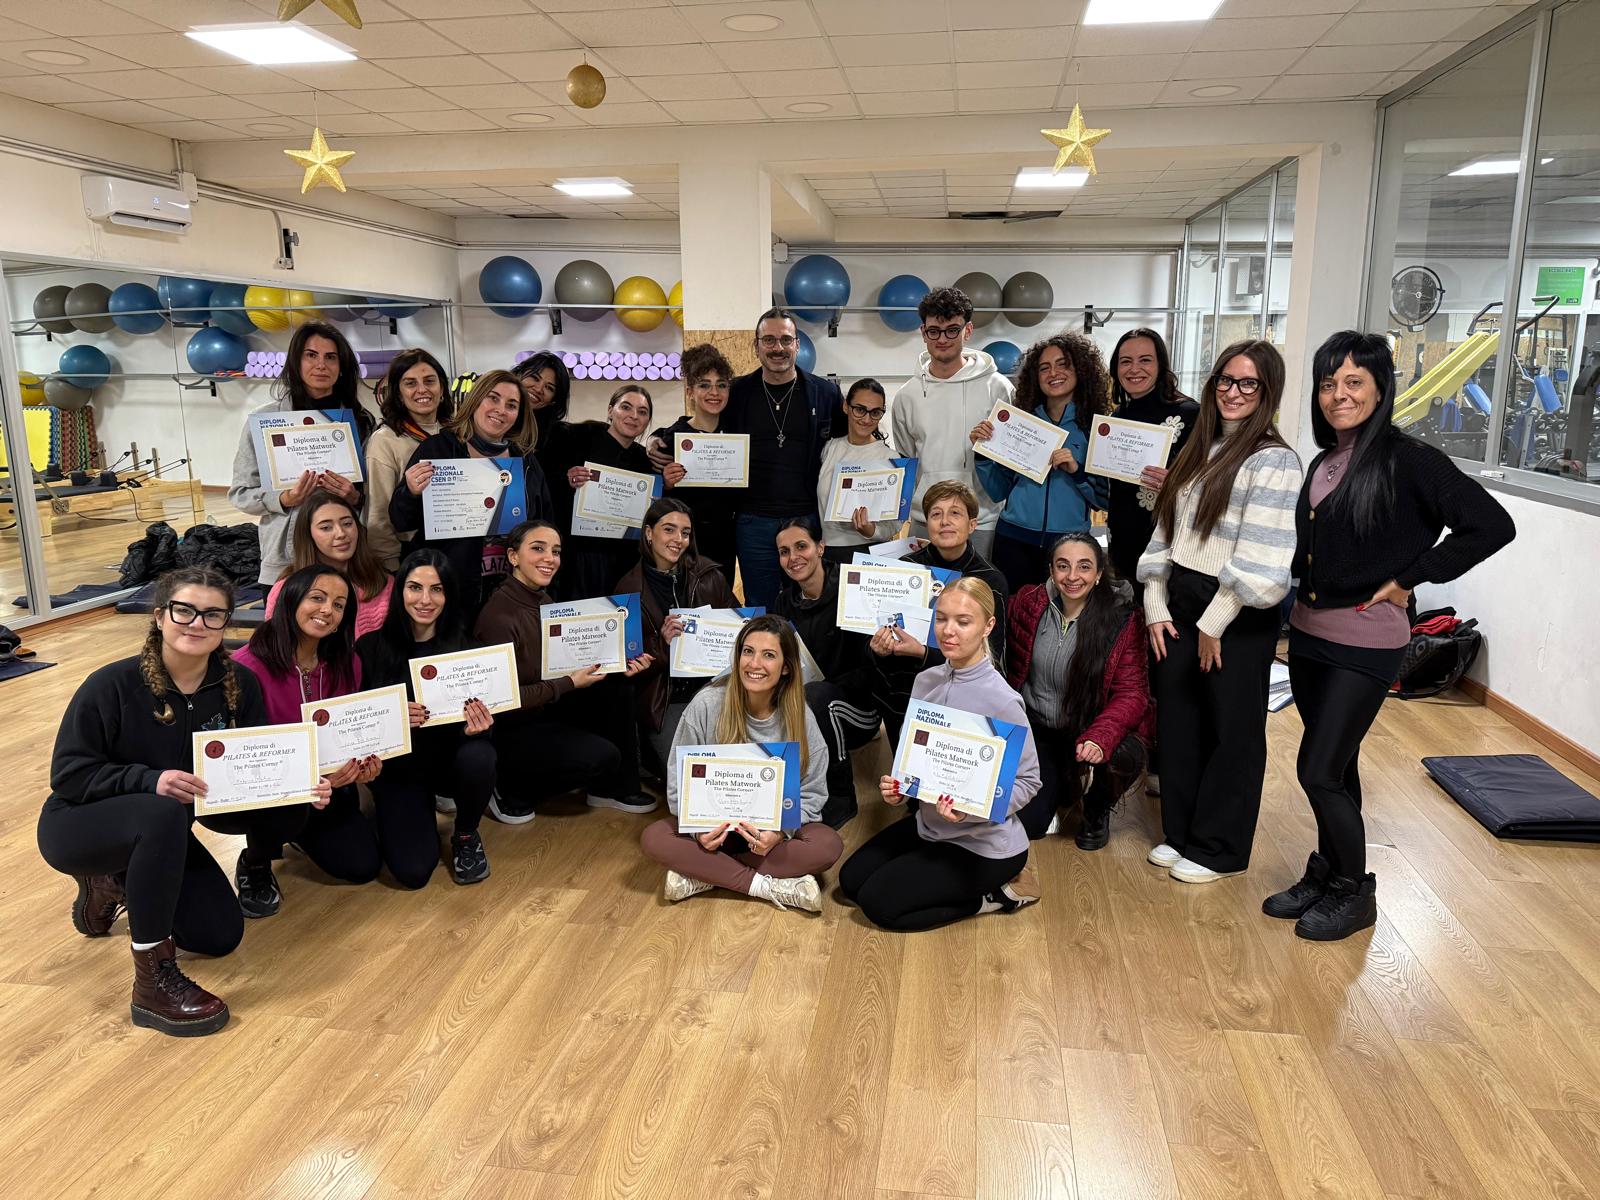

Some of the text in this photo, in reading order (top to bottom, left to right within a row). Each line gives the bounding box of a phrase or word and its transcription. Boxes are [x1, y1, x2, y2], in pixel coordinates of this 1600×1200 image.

[293, 436, 320, 444] Diploma
[309, 443, 336, 451] Matwork
[606, 477, 626, 486] Diploma
[598, 484, 637, 496] Pilates Matwork
[868, 578, 894, 586] Diploma
[696, 635, 714, 643] Pilates
[467, 667, 498, 676] REFORMER
[345, 708, 366, 716] Diploma
[917, 708, 944, 719] DIPLOMA
[329, 718, 351, 727] PILATES
[359, 709, 390, 720] REFORMER
[916, 714, 951, 728] NAZIONALE
[936, 741, 964, 755] Diploma
[223, 753, 250, 761] PILATES
[259, 748, 295, 757] REFORMER
[925, 748, 979, 767] Pilates Matwork
[730, 780, 761, 788] Matwork
